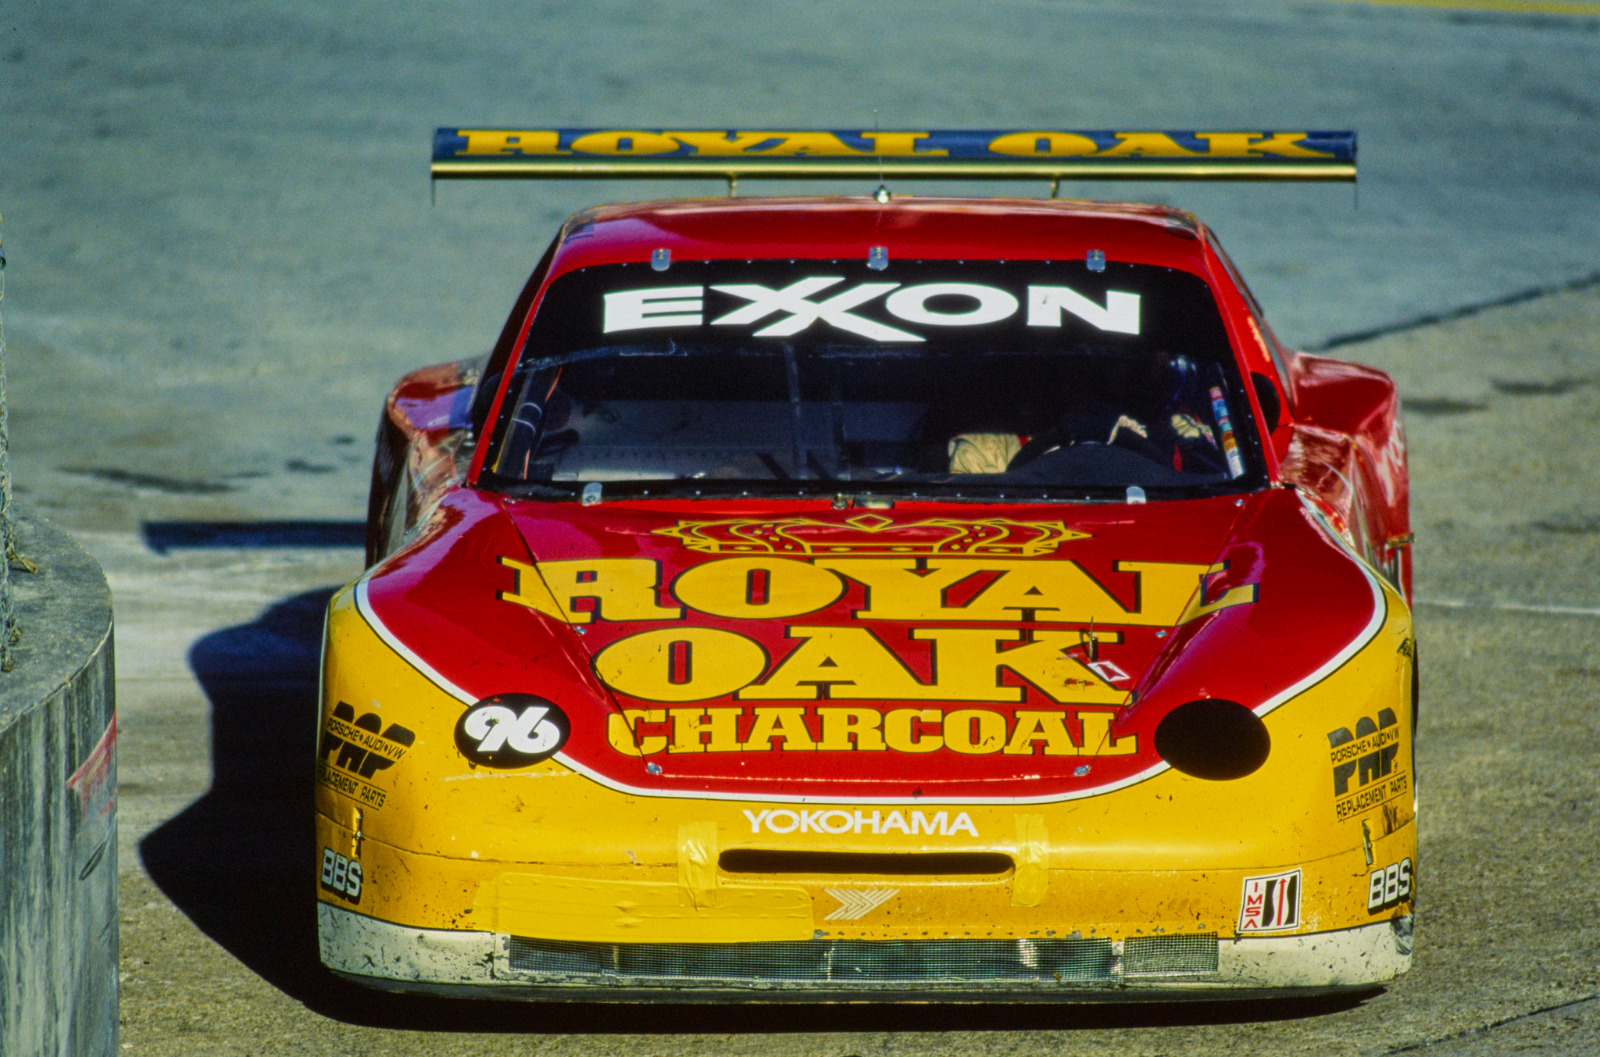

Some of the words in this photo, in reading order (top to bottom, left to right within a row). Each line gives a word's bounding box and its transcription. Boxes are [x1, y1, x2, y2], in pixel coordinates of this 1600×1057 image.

[455, 130, 949, 156] ROYAL
[988, 132, 1335, 157] OAK
[602, 276, 1141, 342] EXXON
[499, 555, 1256, 625] ROYAL
[592, 625, 1138, 708] OAK
[387, 744, 407, 760] VW
[463, 705, 561, 754] 96
[606, 706, 1138, 757] CHARCOAL
[1330, 740, 1367, 764] PORSCHE
[360, 786, 386, 808] PARTS
[1336, 784, 1386, 818] REPLACEMENT
[1389, 775, 1407, 796] PARTS
[742, 809, 980, 837] YOKOHAMA
[320, 848, 364, 905] BBS
[1367, 857, 1412, 915] BBS
[1243, 881, 1263, 929] IMSA
